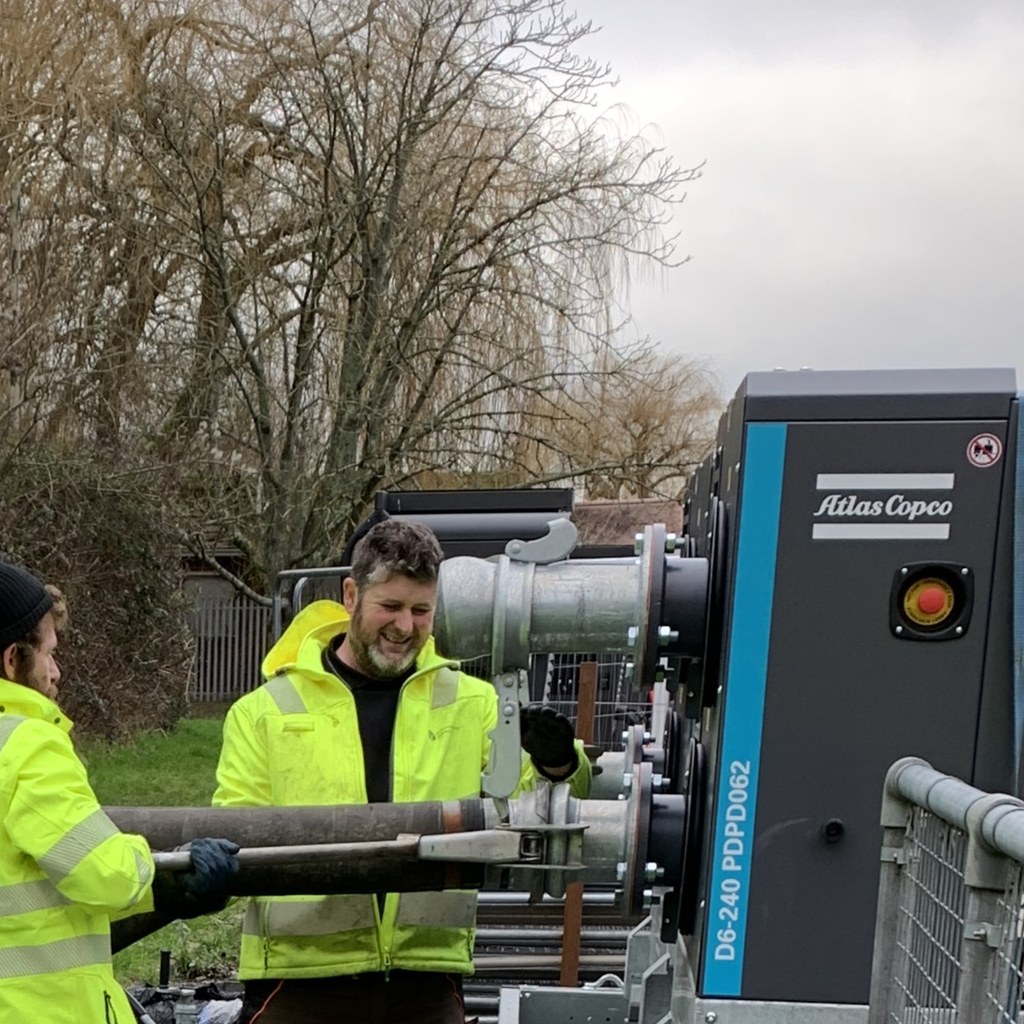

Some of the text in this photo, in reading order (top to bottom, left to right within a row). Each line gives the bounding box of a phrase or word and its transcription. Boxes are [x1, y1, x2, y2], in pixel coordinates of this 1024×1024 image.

[813, 494, 953, 520] Atlas Copco
[714, 760, 751, 961] D6-240 PDPD062
